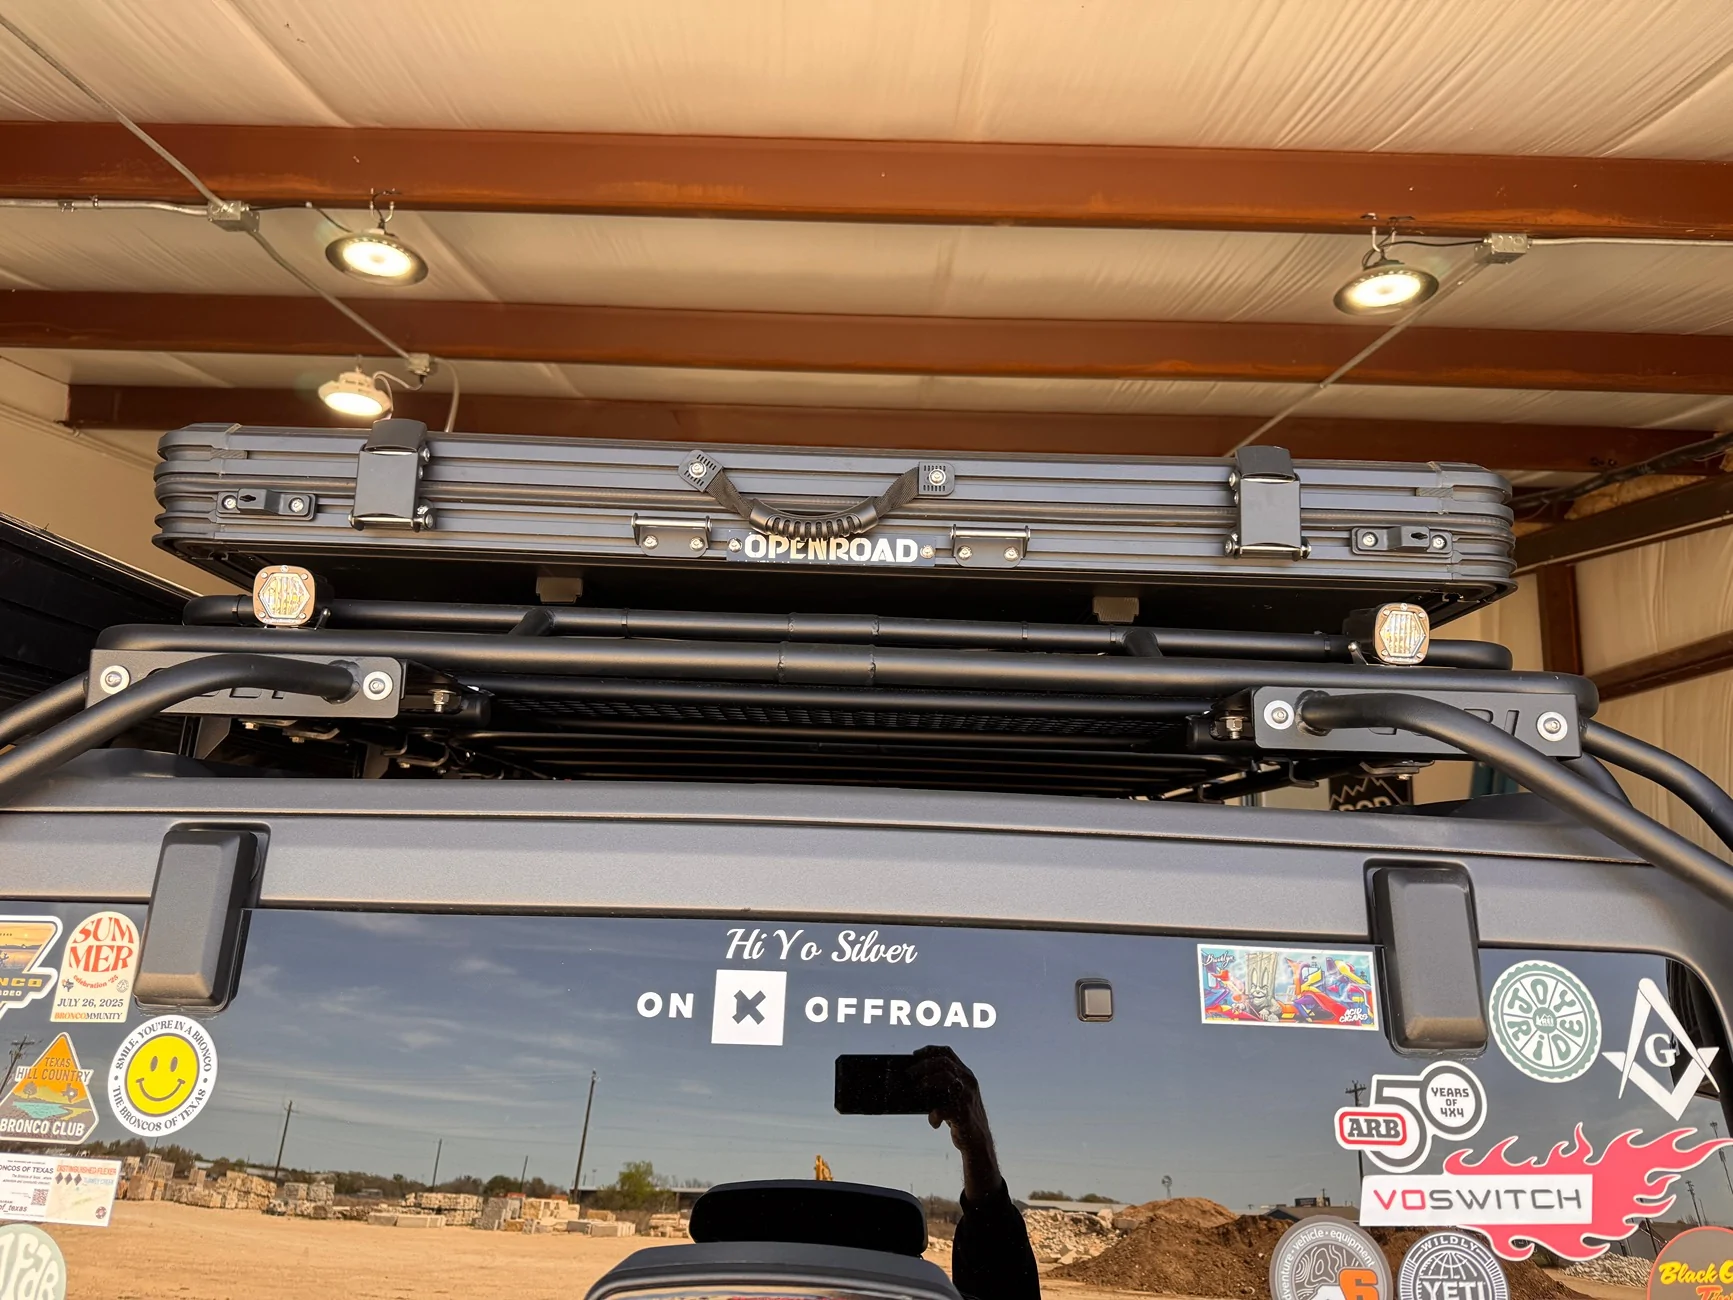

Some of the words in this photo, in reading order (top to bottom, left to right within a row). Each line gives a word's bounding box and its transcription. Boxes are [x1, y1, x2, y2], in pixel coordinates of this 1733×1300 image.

[744, 534, 918, 562] OPENROAD
[72, 917, 134, 944] SUM
[725, 928, 765, 961] Hi
[773, 929, 821, 961] Yo
[831, 930, 918, 964] Silver
[69, 945, 133, 972] MER
[73, 975, 107, 989] celebration
[57, 998, 80, 1007] JULY
[82, 998, 96, 1008] 26,
[100, 998, 124, 1007] 2025
[636, 991, 695, 1019] ON
[804, 996, 997, 1029] OFFROAD
[54, 1012, 122, 1020] BRONCOMMUNITY
[116, 1038, 139, 1070] SMILE,
[137, 1020, 173, 1039] YOU'RE
[174, 1020, 186, 1031] IN
[184, 1026, 193, 1035] A
[191, 1030, 212, 1072] BRONCO
[1644, 1033, 1677, 1068] G
[44, 1057, 71, 1067] TEXAS
[16, 1067, 38, 1080] HILL
[41, 1069, 90, 1083] COUNTRY
[1431, 1087, 1469, 1098] YEARS
[1446, 1099, 1457, 1107] OF
[113, 1085, 123, 1108] THE
[119, 1106, 162, 1132] BRONCOS
[164, 1117, 178, 1129] OF
[178, 1089, 206, 1122] TEXAS
[1370, 1065, 1483, 1168] 50
[0, 1119, 50, 1135] BRONCO
[52, 1121, 85, 1136] CLUB
[1348, 1118, 1400, 1139] ARB
[1373, 1189, 1582, 1211] VOSWITCH
[1293, 1228, 1324, 1250] vehicle
[1330, 1229, 1375, 1267] equipment
[1421, 1236, 1478, 1251] WILDLY
[1659, 1261, 1718, 1285] Black
[1422, 1281, 1485, 1300] YETI
